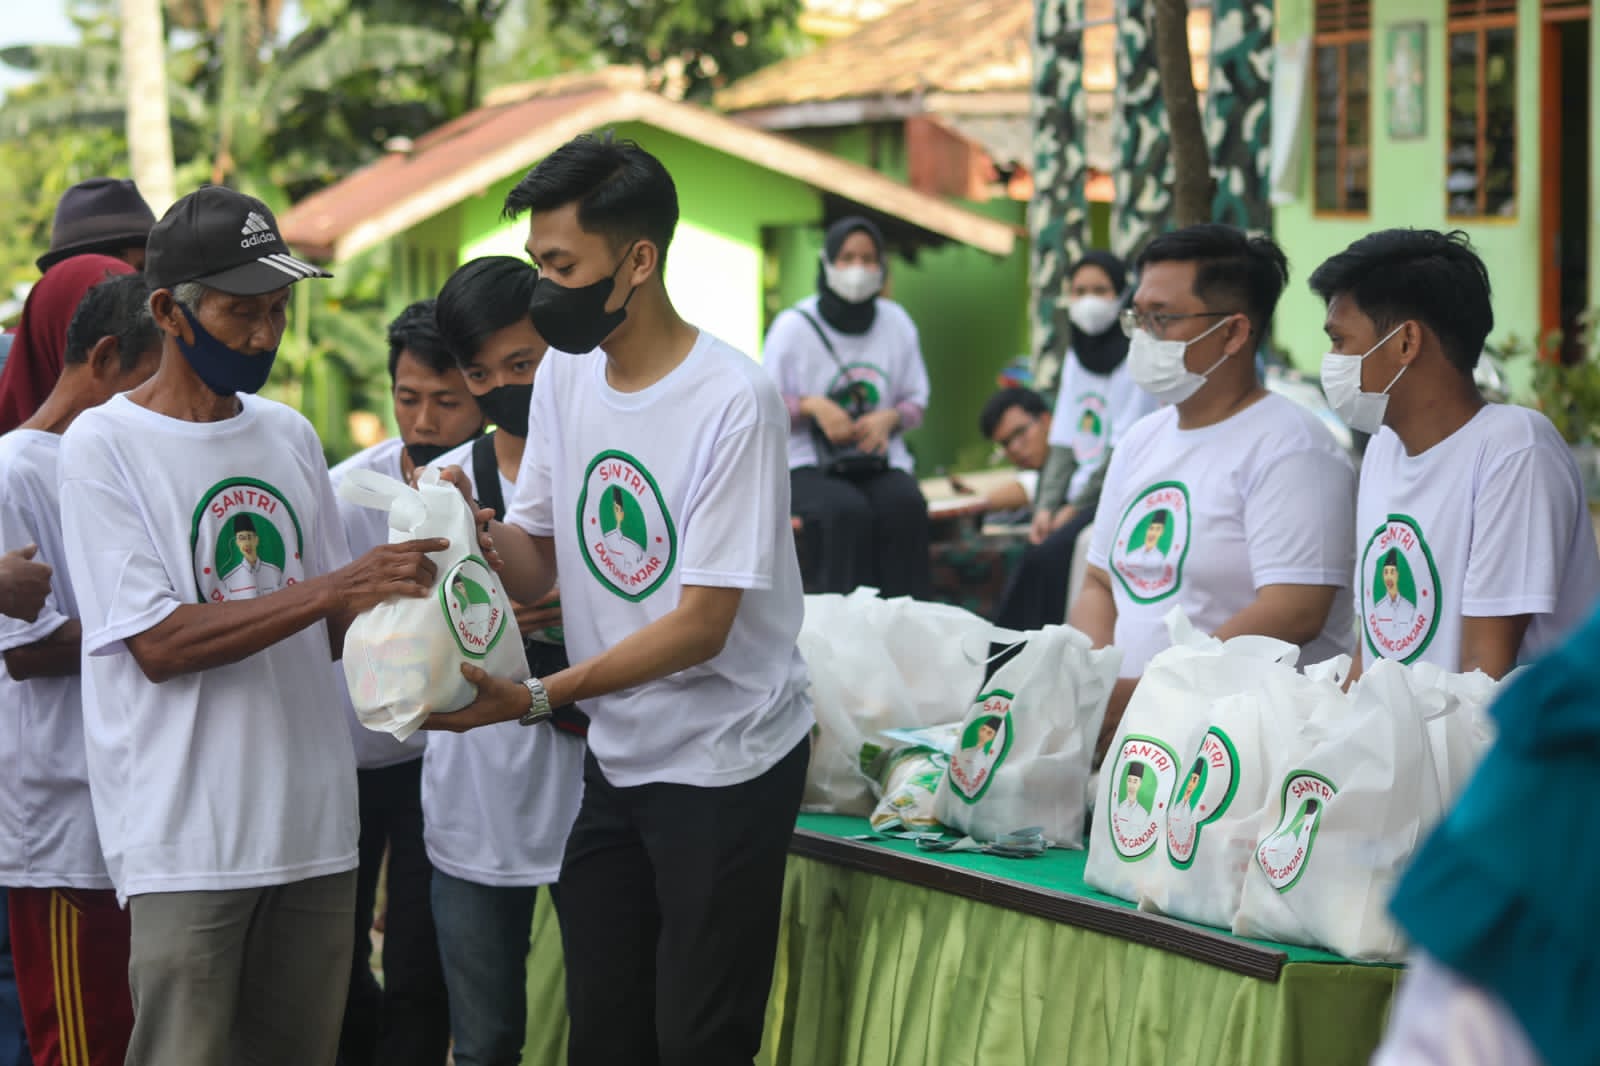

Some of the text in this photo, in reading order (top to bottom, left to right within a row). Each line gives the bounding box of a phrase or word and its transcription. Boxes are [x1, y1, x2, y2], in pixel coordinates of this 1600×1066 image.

[211, 490, 277, 519] SANTRI
[628, 556, 662, 586] NJAR
[1123, 744, 1170, 772] SANTRI
[1292, 780, 1333, 801] SANTRI
[1128, 822, 1158, 849] GANJAR
